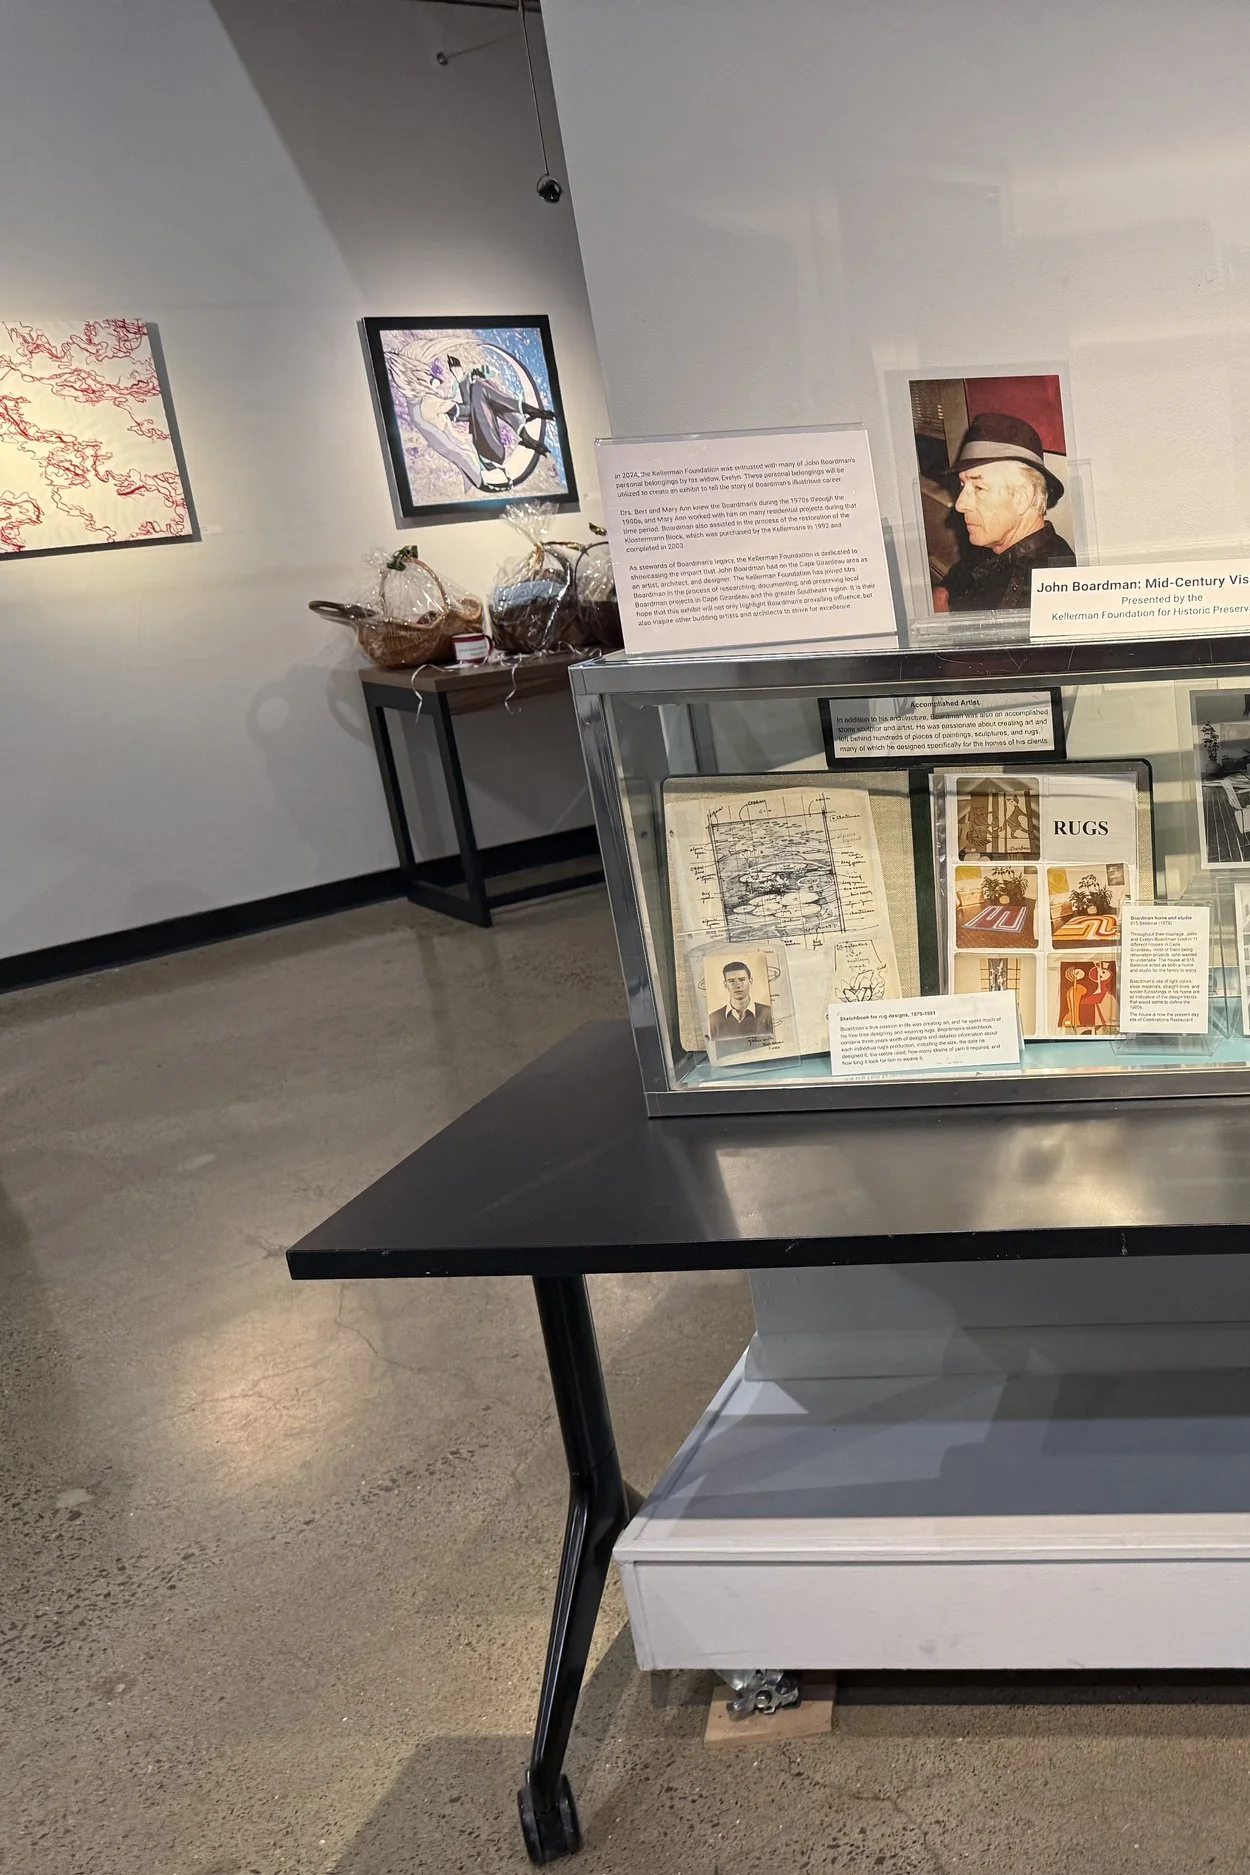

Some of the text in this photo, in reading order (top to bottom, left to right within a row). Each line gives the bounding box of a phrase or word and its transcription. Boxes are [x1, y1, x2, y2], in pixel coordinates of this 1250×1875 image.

[1036, 582, 1067, 592] John
[1072, 579, 1140, 591] Boardman:
[1145, 575, 1224, 589] Mid-Century
[1121, 596, 1170, 604] Presented
[1173, 595, 1185, 603] by
[1051, 612, 1098, 620] Kellerman
[1101, 609, 1154, 618] Foundation
[1173, 606, 1210, 614] Historic
[1054, 820, 1109, 836] RUGS
